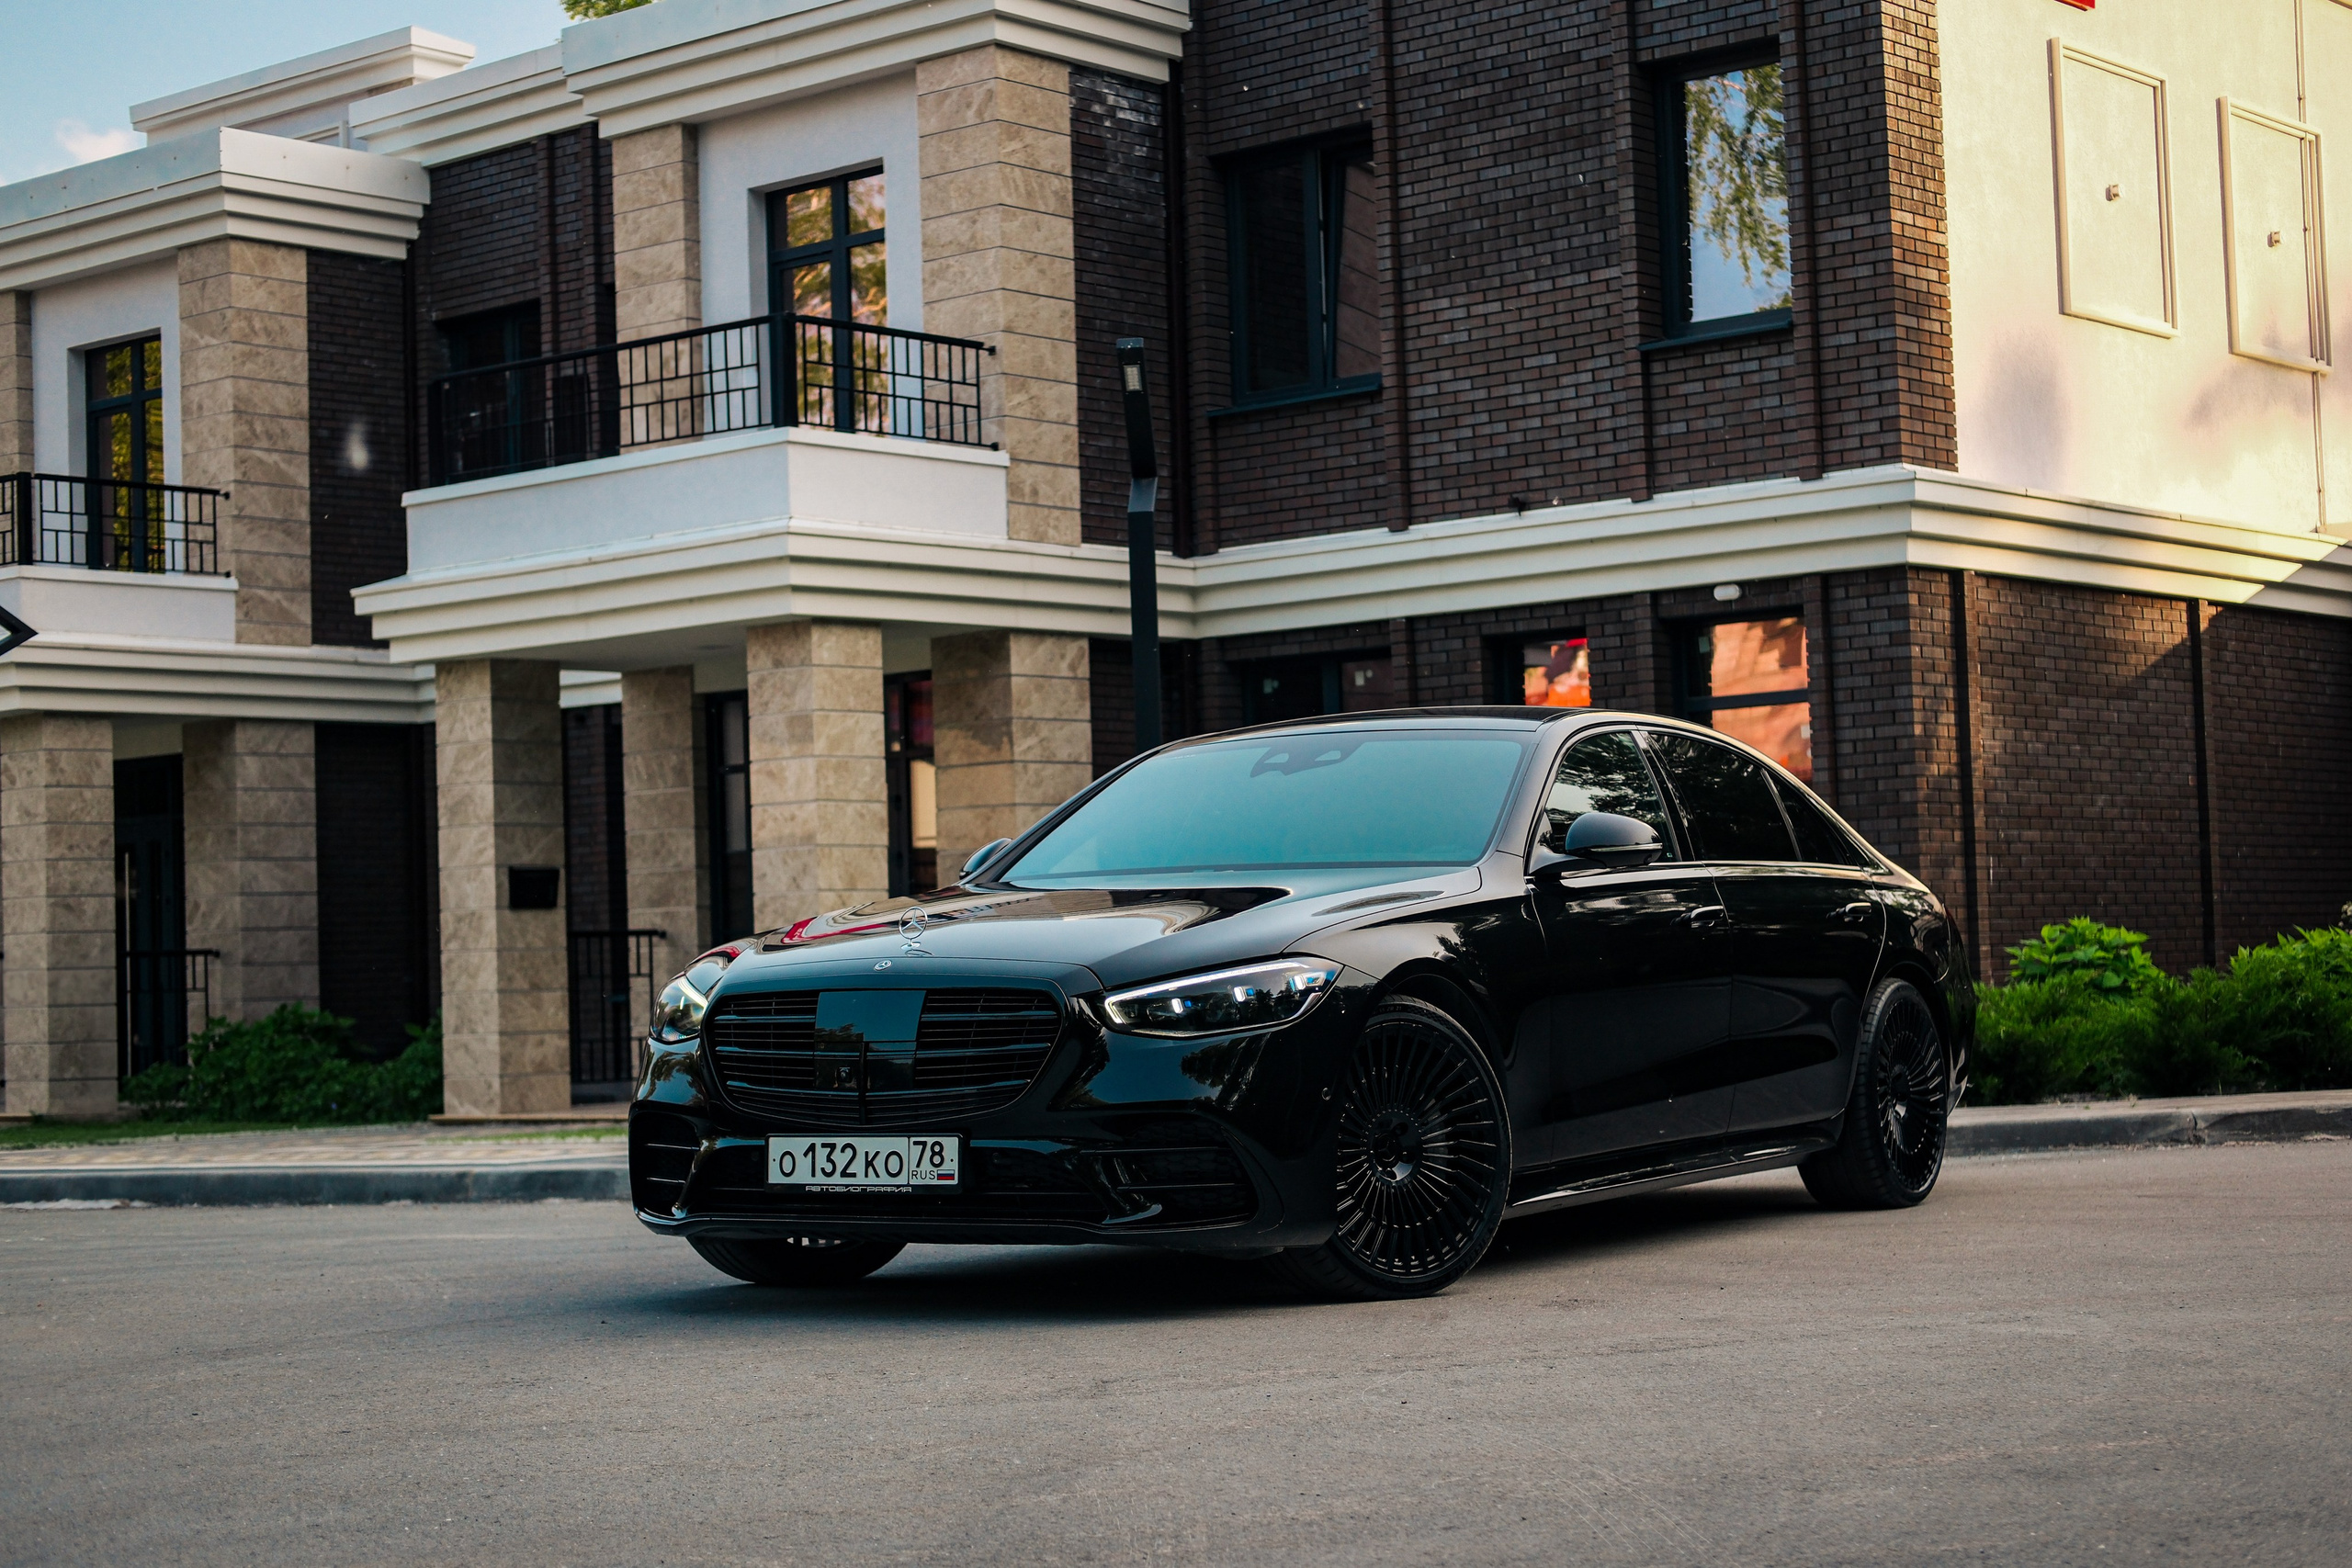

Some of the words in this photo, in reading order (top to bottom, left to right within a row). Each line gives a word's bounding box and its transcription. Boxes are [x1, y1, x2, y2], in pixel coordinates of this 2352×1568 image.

[912, 1140, 944, 1168] 78
[910, 1169, 936, 1180] RUS
[805, 1185, 912, 1193] АВТОБИОГРАФИЯ
